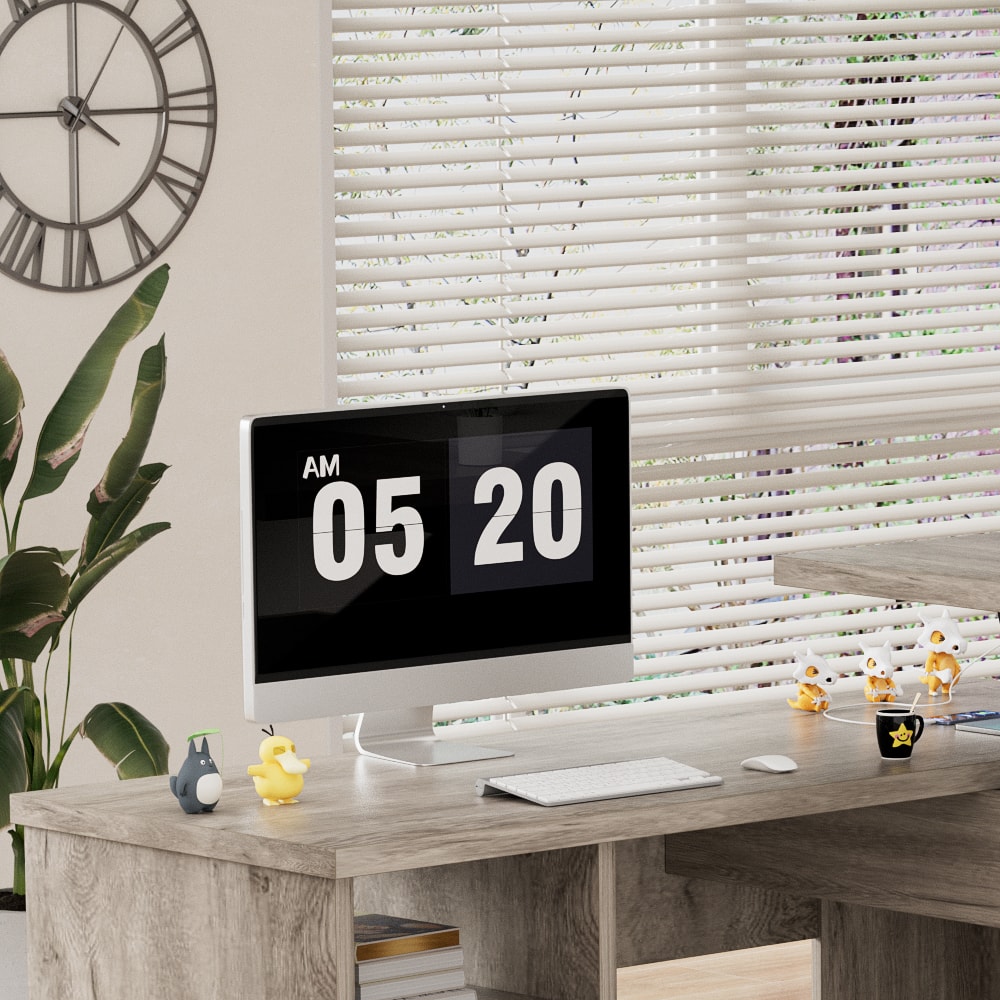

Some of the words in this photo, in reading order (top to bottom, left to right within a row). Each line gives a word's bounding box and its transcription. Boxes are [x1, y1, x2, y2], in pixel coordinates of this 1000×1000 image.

[302, 453, 340, 480] AM
[312, 475, 425, 582] 05
[473, 461, 584, 566] 20
